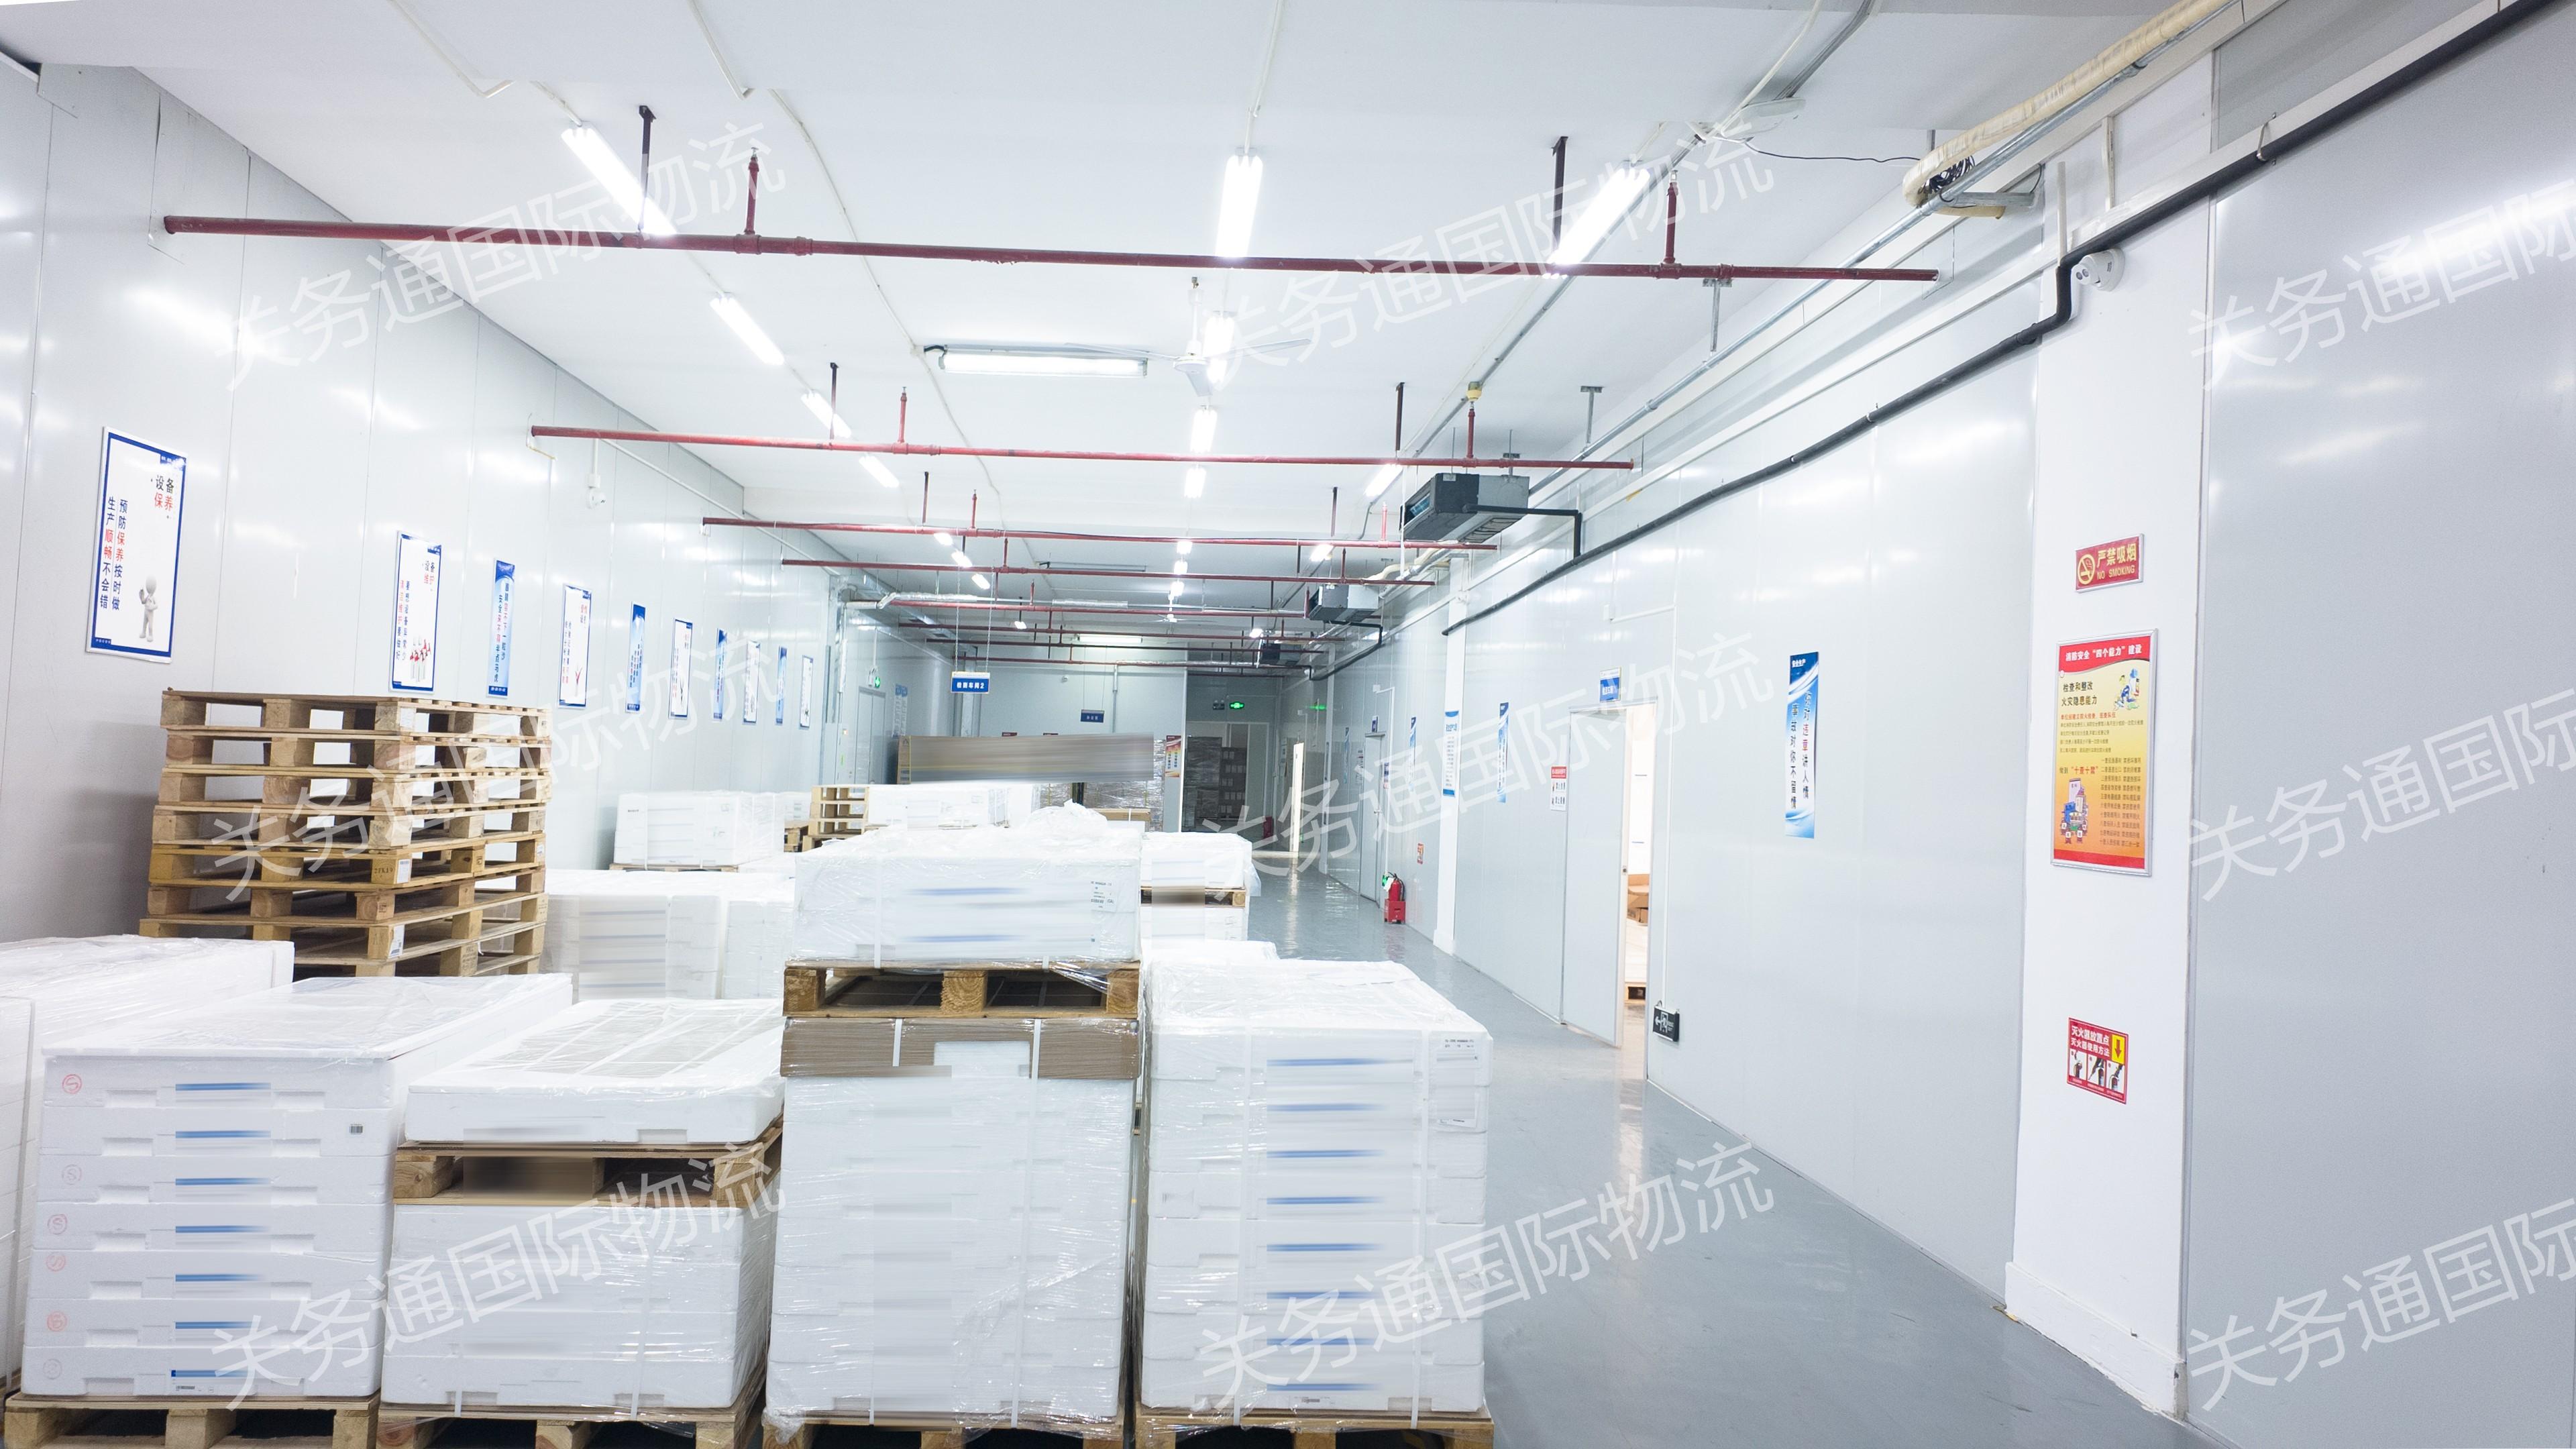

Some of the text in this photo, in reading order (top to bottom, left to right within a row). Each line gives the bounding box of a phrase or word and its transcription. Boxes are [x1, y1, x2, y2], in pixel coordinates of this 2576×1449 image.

[155, 475, 174, 494] 设备
[154, 492, 174, 511] 保养
[100, 496, 116, 609] 生产顺畅不会错
[112, 499, 128, 610] 预防保养按时做
[2097, 543, 2137, 568] 严禁吸烟
[2097, 565, 2135, 580] NO SMOKING
[2071, 1037, 2110, 1057] 灭火器使用方法
